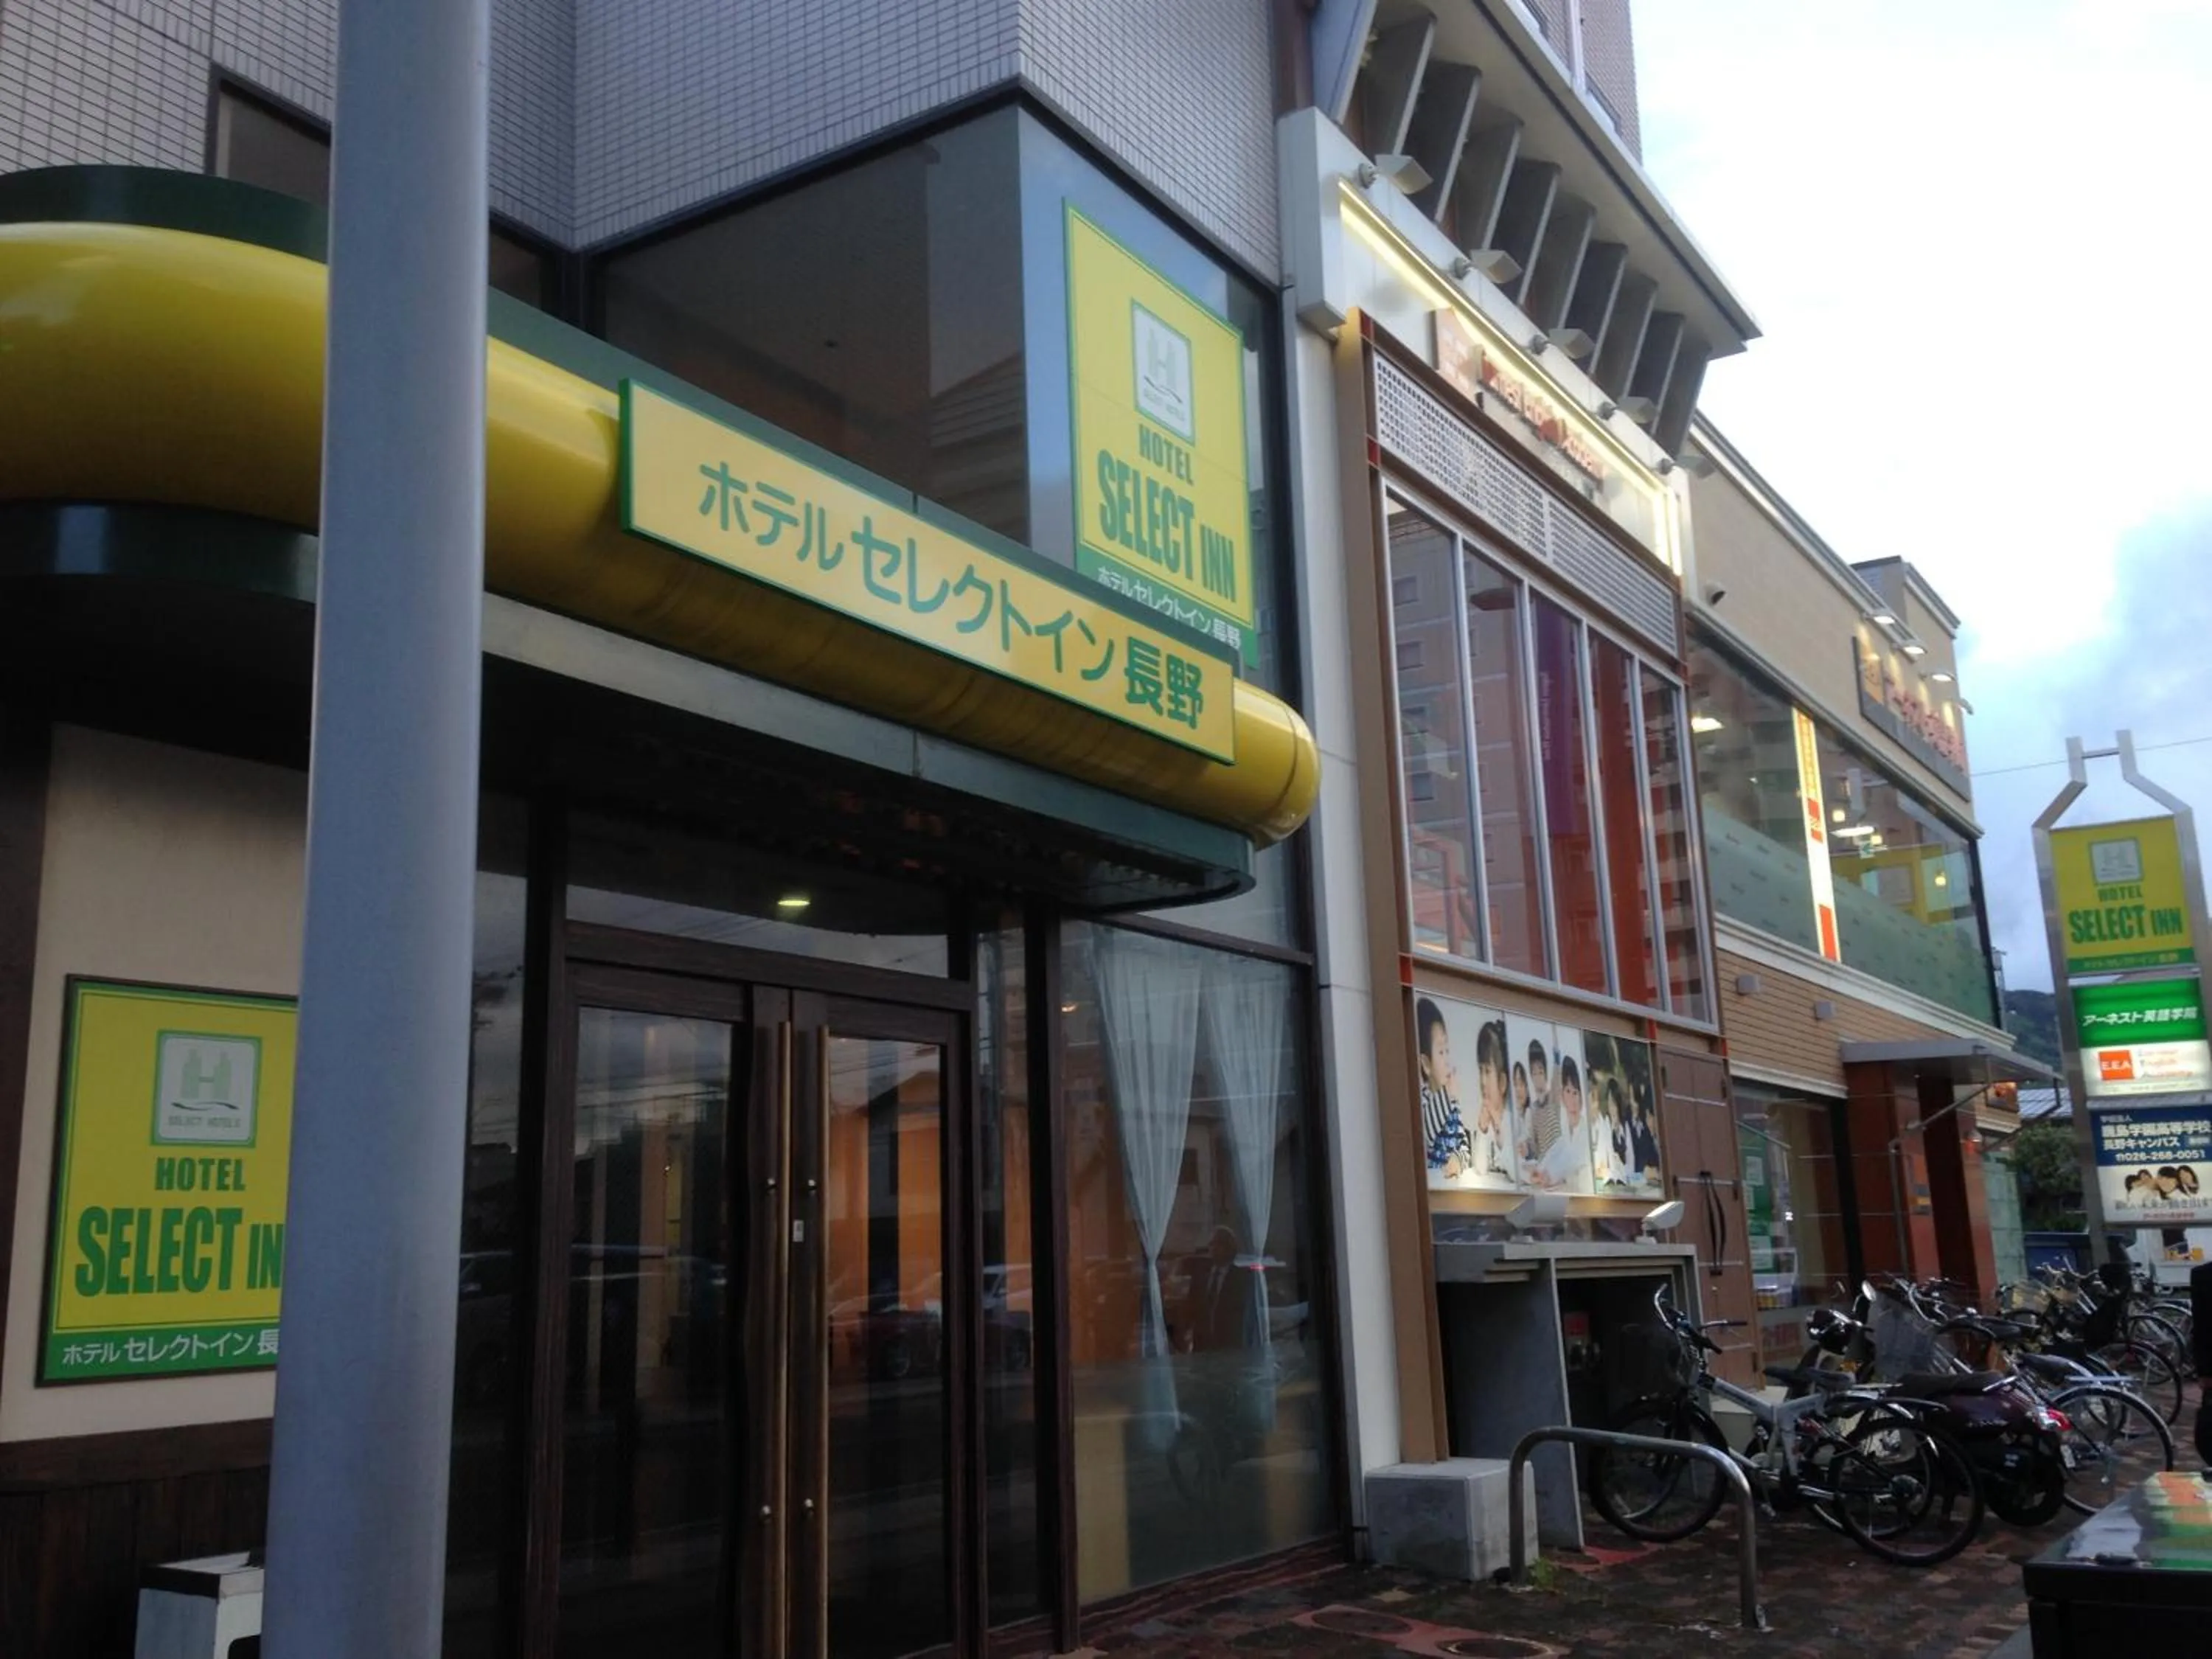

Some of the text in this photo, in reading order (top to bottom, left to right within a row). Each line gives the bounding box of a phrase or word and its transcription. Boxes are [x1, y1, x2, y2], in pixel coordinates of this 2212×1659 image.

[1139, 423, 1194, 485] HOTEL
[1096, 449, 1237, 603] SELECT INN
[699, 461, 1204, 729] ホテルセレクトイン長野
[2098, 886, 2143, 902] HOTEL
[2069, 905, 2183, 944] SELECT INN
[154, 1157, 246, 1192] HOTEL
[75, 1206, 285, 1298] SELECT IN
[63, 1329, 279, 1366] ホテルセレクトイン長
